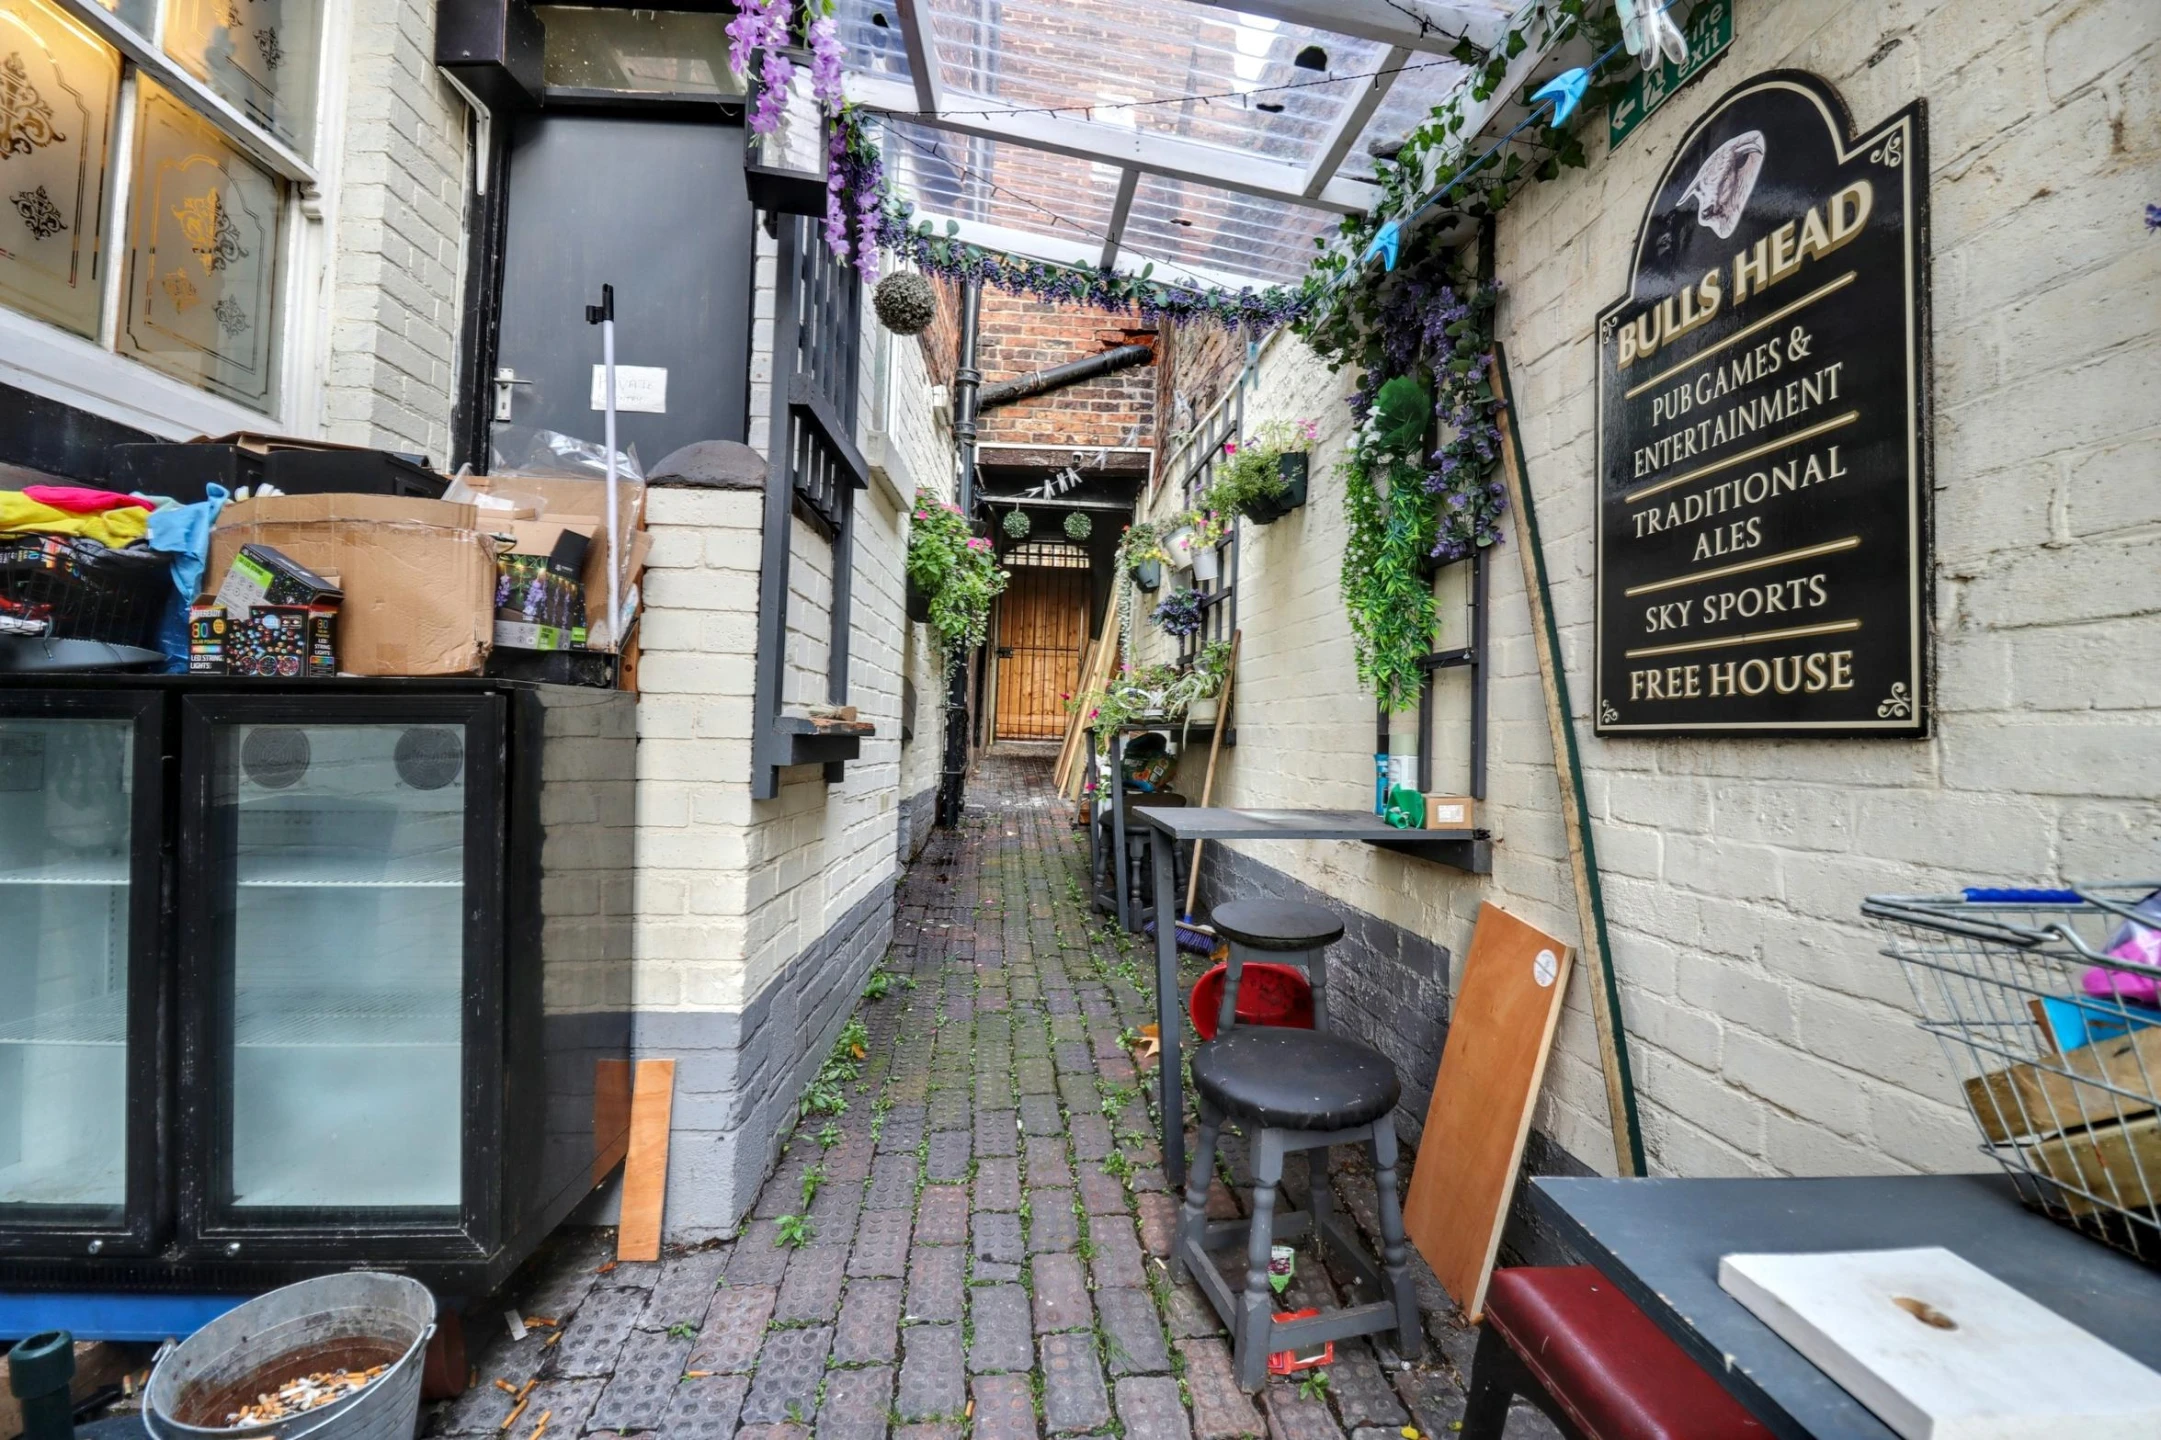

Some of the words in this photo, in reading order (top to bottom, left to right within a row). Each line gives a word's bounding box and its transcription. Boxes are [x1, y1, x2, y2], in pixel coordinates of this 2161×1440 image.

[1683, 3, 1723, 42] ire
[1678, 26, 1720, 78] exit
[1617, 267, 1722, 371] BULLS
[1733, 179, 1874, 307] HEAD
[1652, 383, 1692, 427] PUB
[1695, 336, 1782, 405] GAMES
[1787, 325, 1812, 362] &
[1634, 362, 1843, 479] ENTERTAINMENT
[1632, 445, 1848, 539] TRADITIONAL
[1691, 516, 1762, 562] ALES
[1645, 599, 1693, 633] SKY
[1703, 573, 1827, 624] SPORTS
[191, 622, 209, 638] 80
[190, 654, 202, 662] LED
[202, 654, 224, 662] STRING
[190, 662, 212, 670] LIGHTS
[1630, 664, 1701, 701] FREE
[1709, 649, 1855, 697] HOUSE
